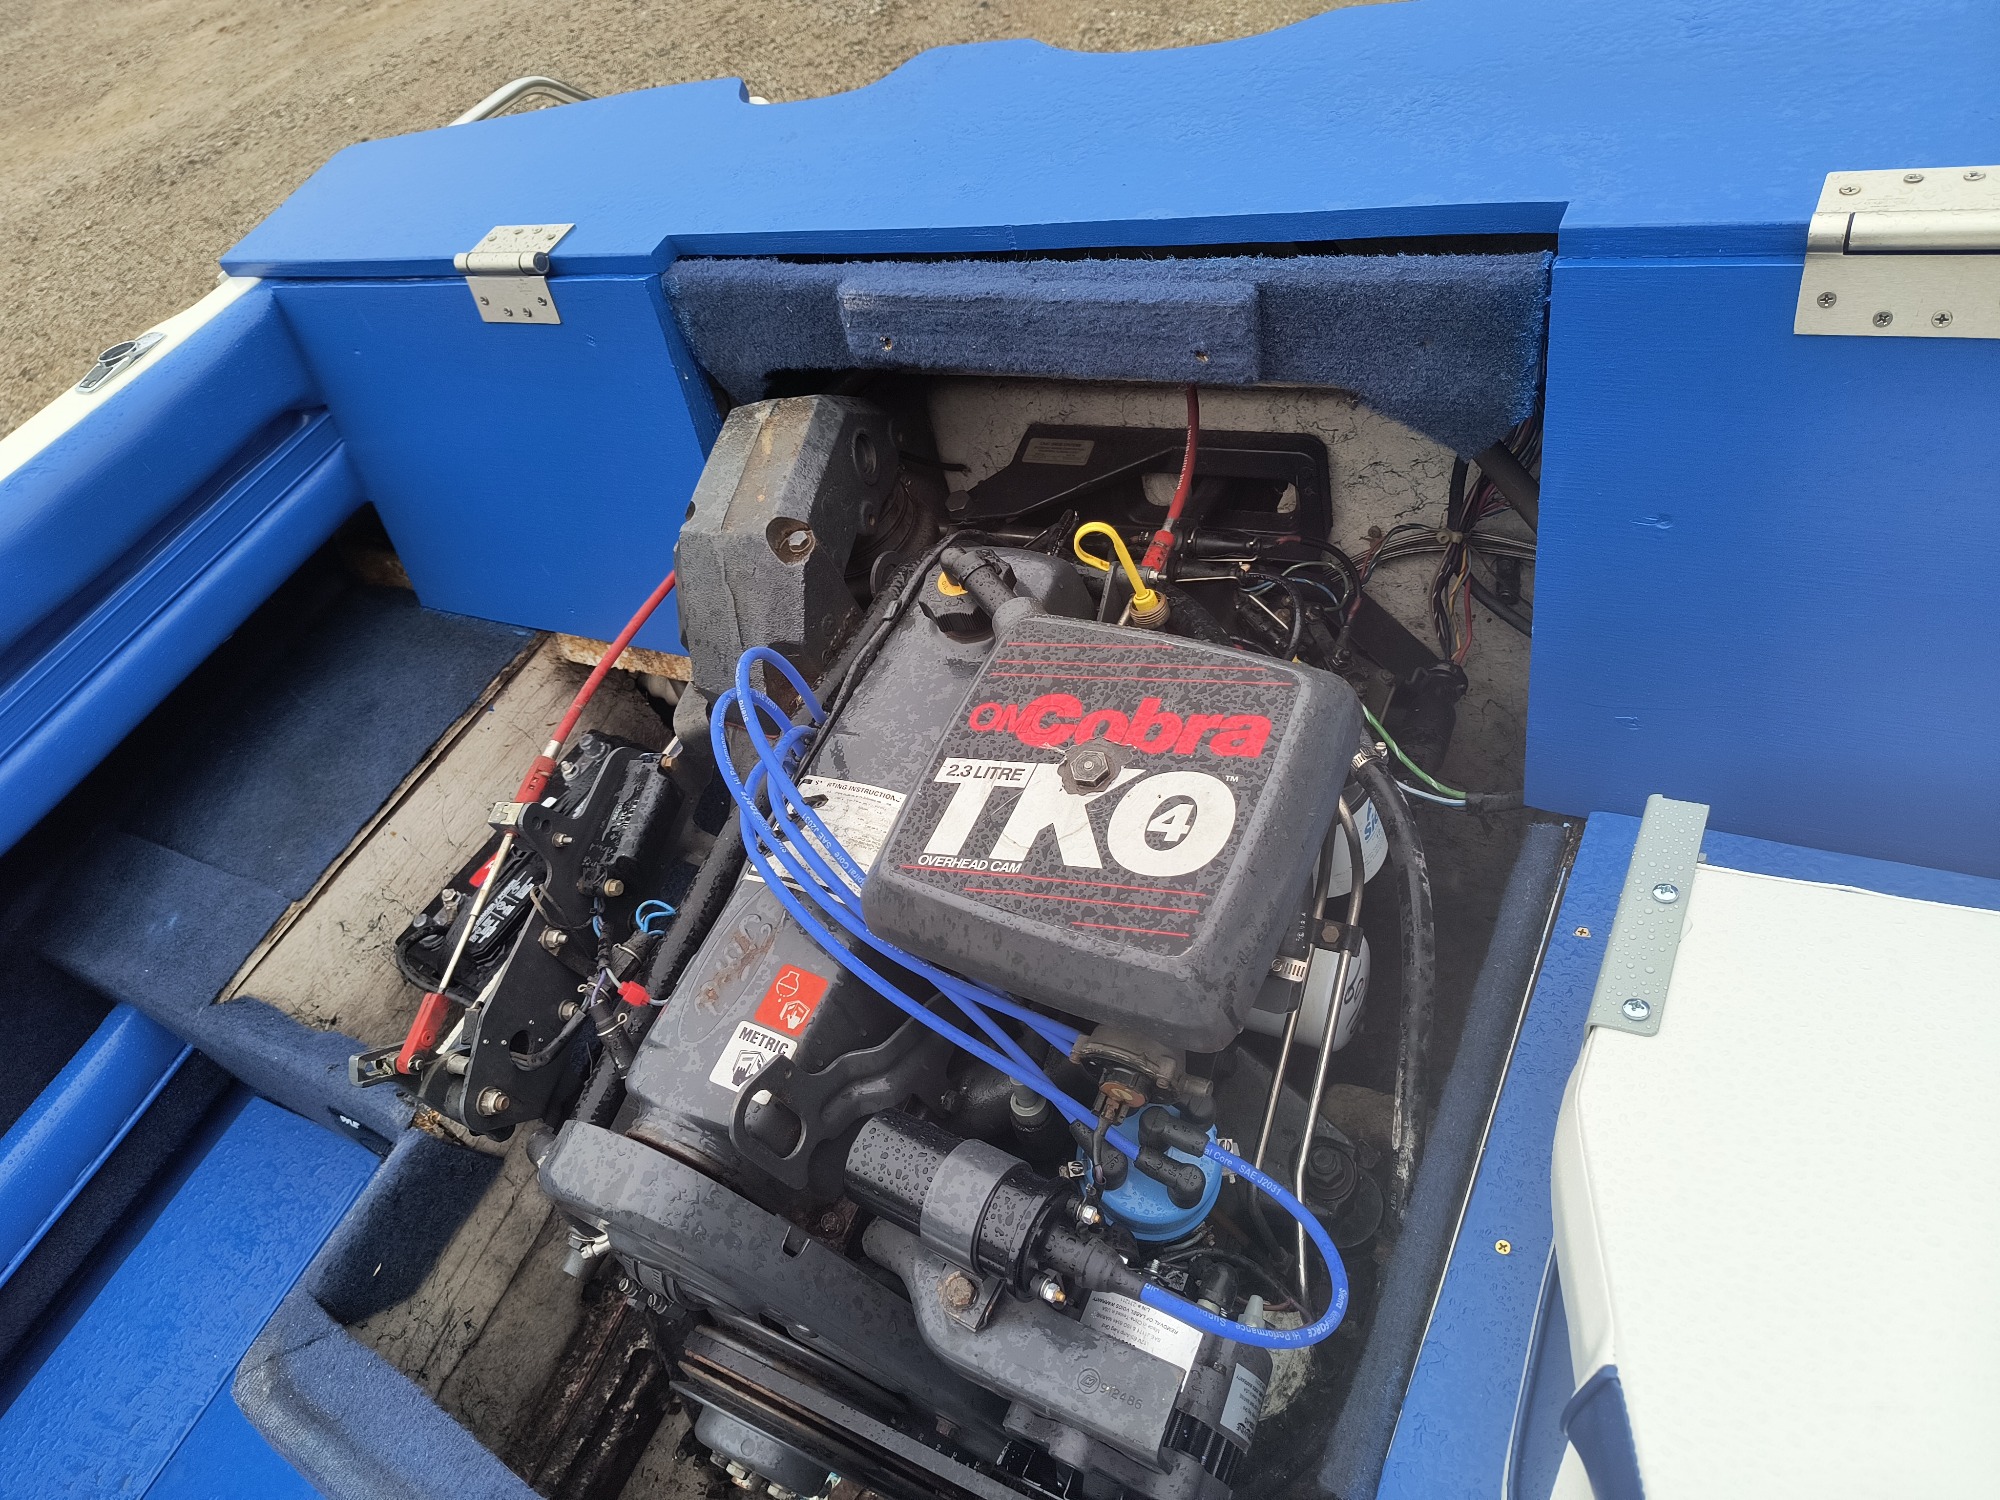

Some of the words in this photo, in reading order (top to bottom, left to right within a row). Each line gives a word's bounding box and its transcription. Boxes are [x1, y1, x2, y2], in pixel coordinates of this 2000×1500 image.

[968, 702, 1066, 736] OMC
[1014, 693, 1271, 758] Cobra
[945, 765, 973, 779] 2.3
[973, 766, 1027, 782] LITRE
[801, 812, 821, 836] J2031
[923, 757, 1236, 877] TKO
[1147, 803, 1194, 842] 4
[817, 833, 833, 850] SAE
[834, 852, 849, 872] Core
[917, 854, 989, 872] OVERHEAD
[989, 860, 1023, 874] CAM
[738, 1026, 790, 1056] METRIC
[1213, 1151, 1233, 1167] Core
[1238, 1164, 1257, 1181] SAE
[1257, 1176, 1282, 1196] J2031
[1335, 1287, 1348, 1311] Sierra
[1235, 1322, 1294, 1341] Performance
[1293, 1330, 1302, 1341] Hi
